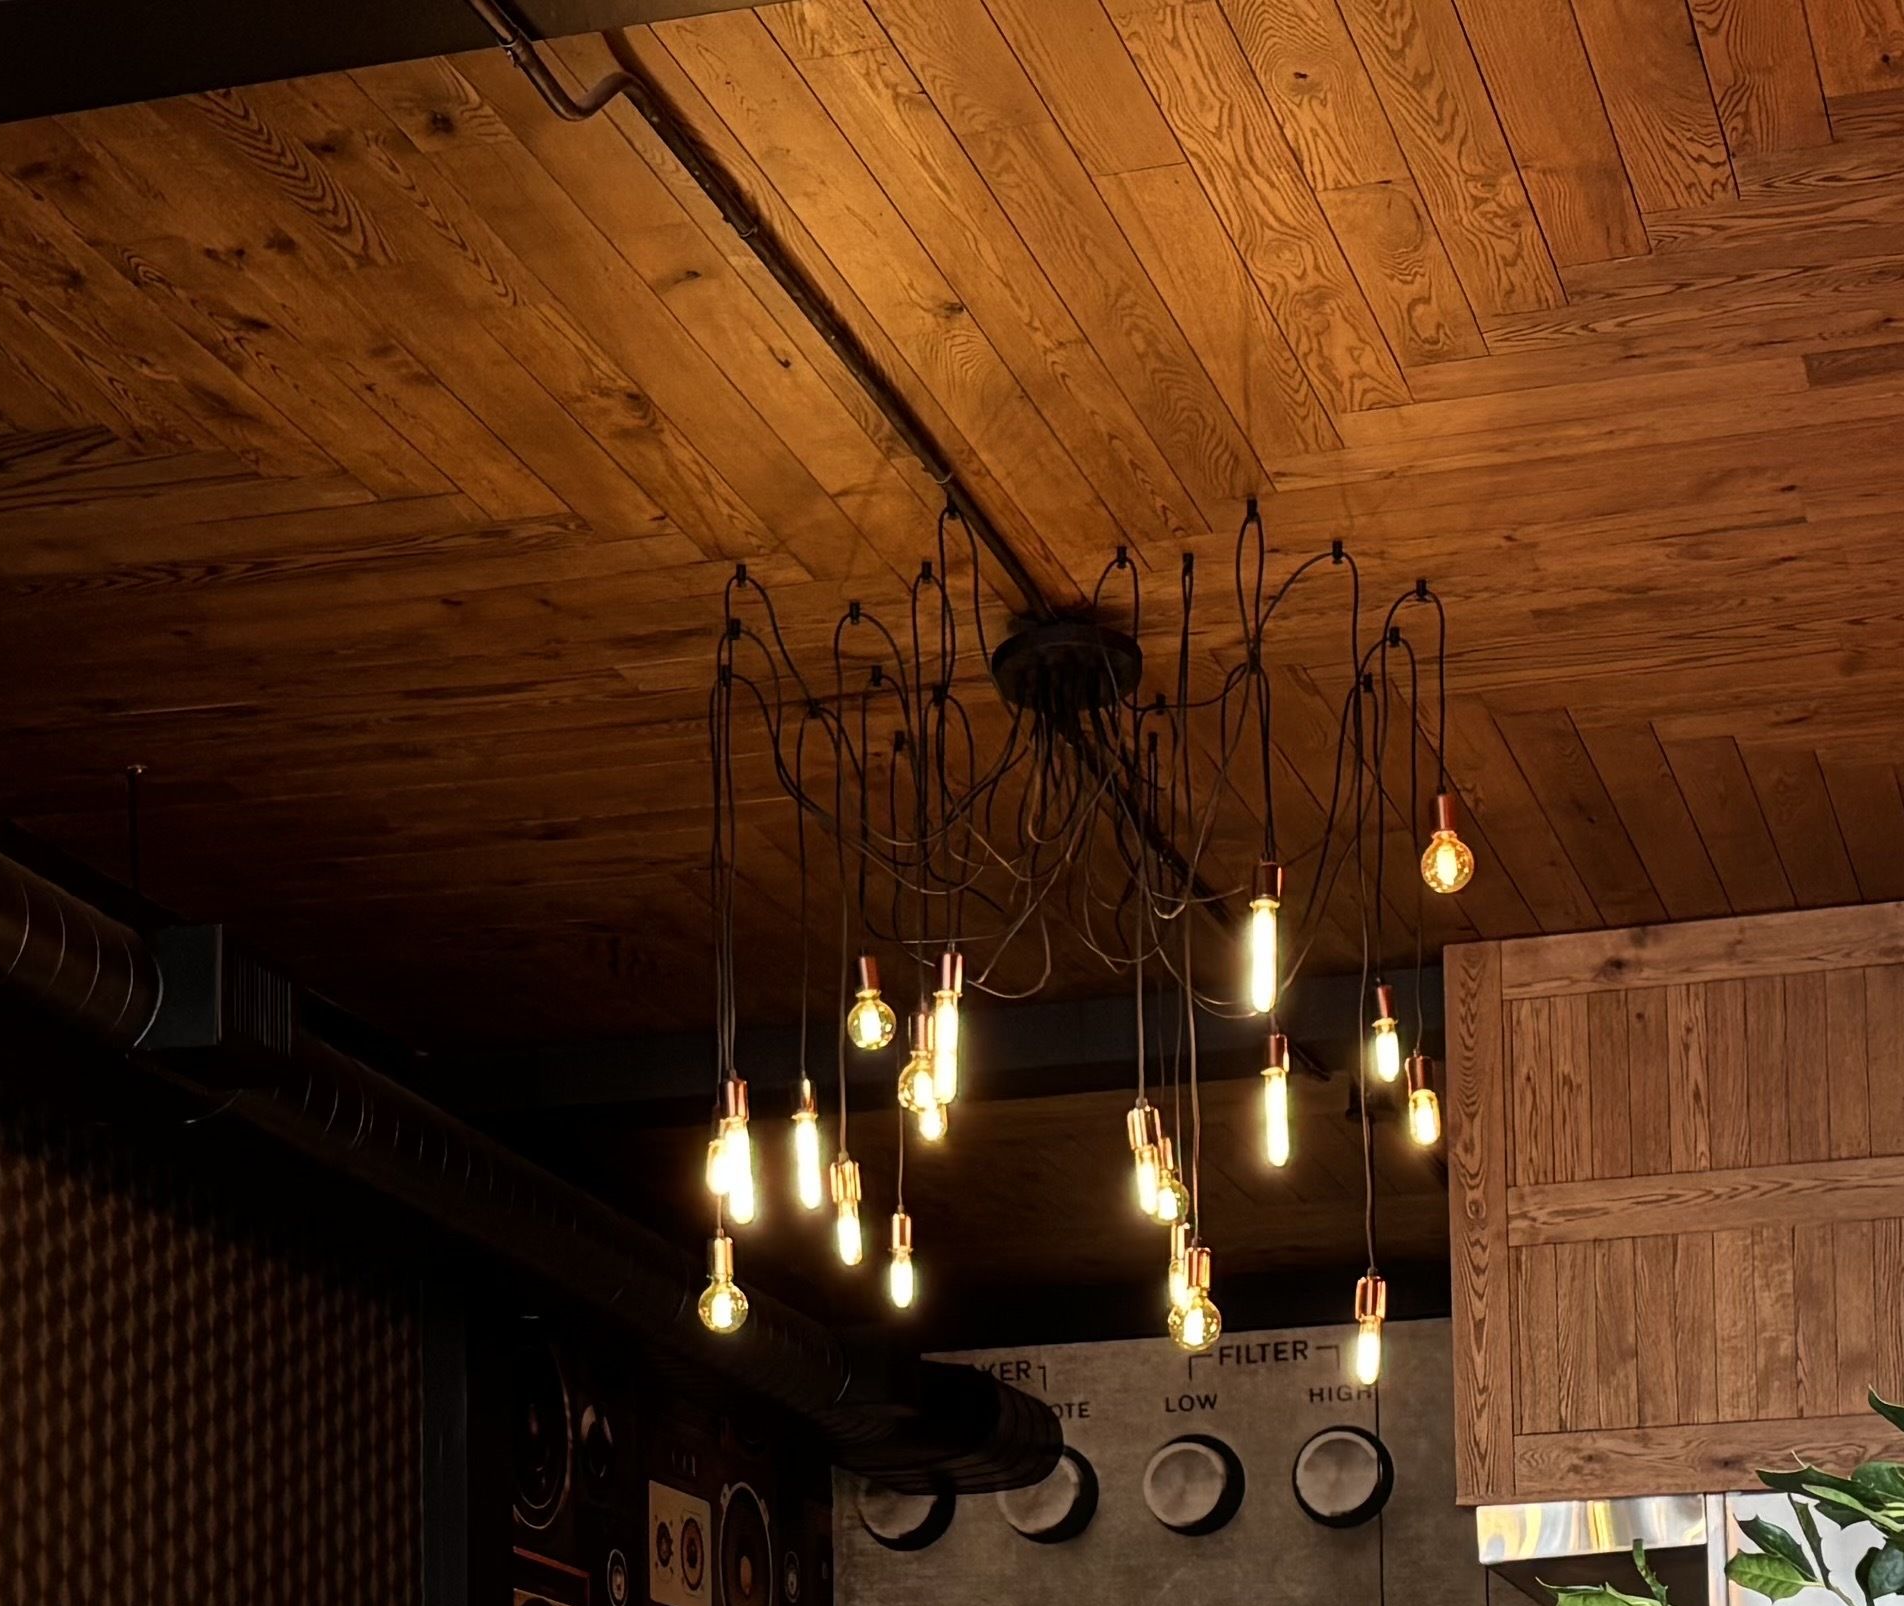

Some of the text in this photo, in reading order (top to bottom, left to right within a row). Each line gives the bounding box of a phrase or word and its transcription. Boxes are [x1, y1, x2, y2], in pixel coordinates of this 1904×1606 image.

[1218, 1340, 1309, 1366] FILTER
[1164, 1393, 1218, 1413] LOW
[1308, 1385, 1373, 1404] HIGH
